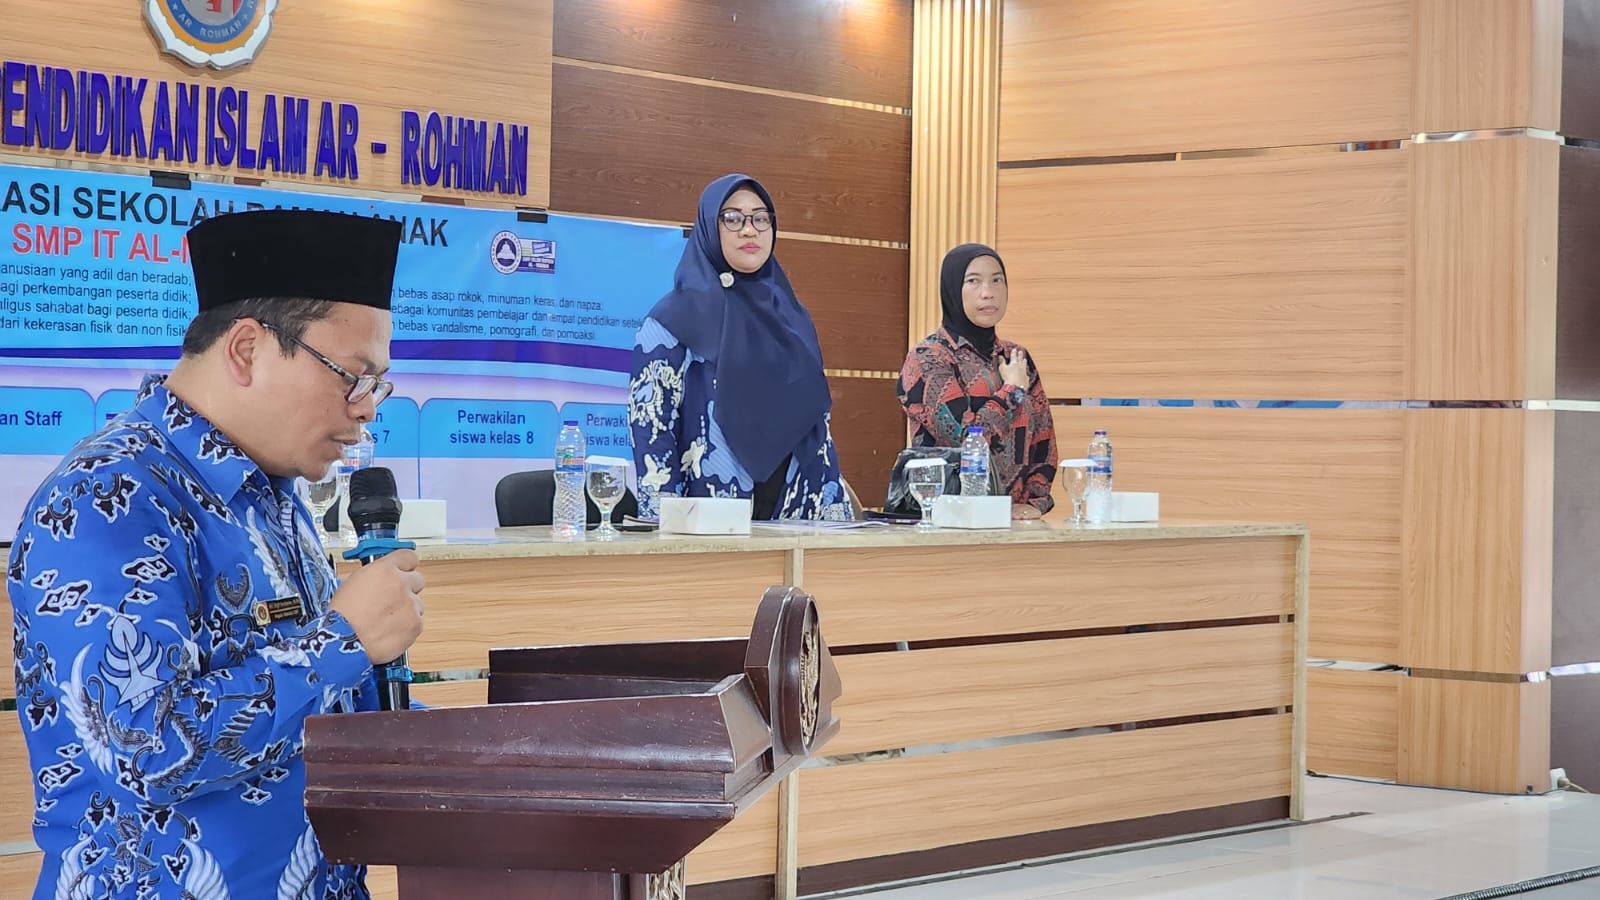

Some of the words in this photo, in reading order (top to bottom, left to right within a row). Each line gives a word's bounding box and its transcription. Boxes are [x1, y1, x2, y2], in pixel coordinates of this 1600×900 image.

[178, 13, 193, 29] AR
[199, 21, 243, 39] ROHMAN
[0, 61, 200, 163] ENDIDIKAN
[205, 86, 309, 175] ISLAM
[314, 101, 359, 180] AR
[400, 110, 529, 196] ROHMAN
[0, 180, 60, 217] ASI
[11, 222, 83, 257] SMP
[92, 228, 121, 260] IT
[60, 267, 89, 281] yang
[92, 267, 113, 281] adil
[117, 268, 139, 282] dan
[22, 281, 112, 300] perkembangan
[116, 288, 159, 301] peserta
[162, 289, 192, 304] didik;
[398, 286, 429, 300] bebas
[431, 290, 456, 303] asap
[487, 293, 531, 305] minuman
[35, 300, 84, 314] sahabat
[87, 302, 113, 318] bagi
[116, 305, 159, 319] peserta
[391, 303, 425, 317] ebagai
[427, 305, 475, 319] komunitas
[477, 308, 529, 323] pembelajar
[577, 314, 621, 328] pendidikan
[24, 316, 87, 332] kekerasan
[90, 320, 113, 333] fisik
[117, 322, 138, 334] dan
[141, 325, 163, 336] non
[398, 319, 429, 332] bebas
[431, 321, 487, 336] vandalisme,
[24, 409, 63, 427] Staff
[457, 409, 526, 425] Perwakilan
[586, 412, 628, 428] Perwaki
[383, 429, 391, 444] 7
[449, 430, 486, 444] siswa
[490, 430, 522, 445] kelas
[526, 430, 535, 445] 8
[585, 433, 610, 446] iswa
